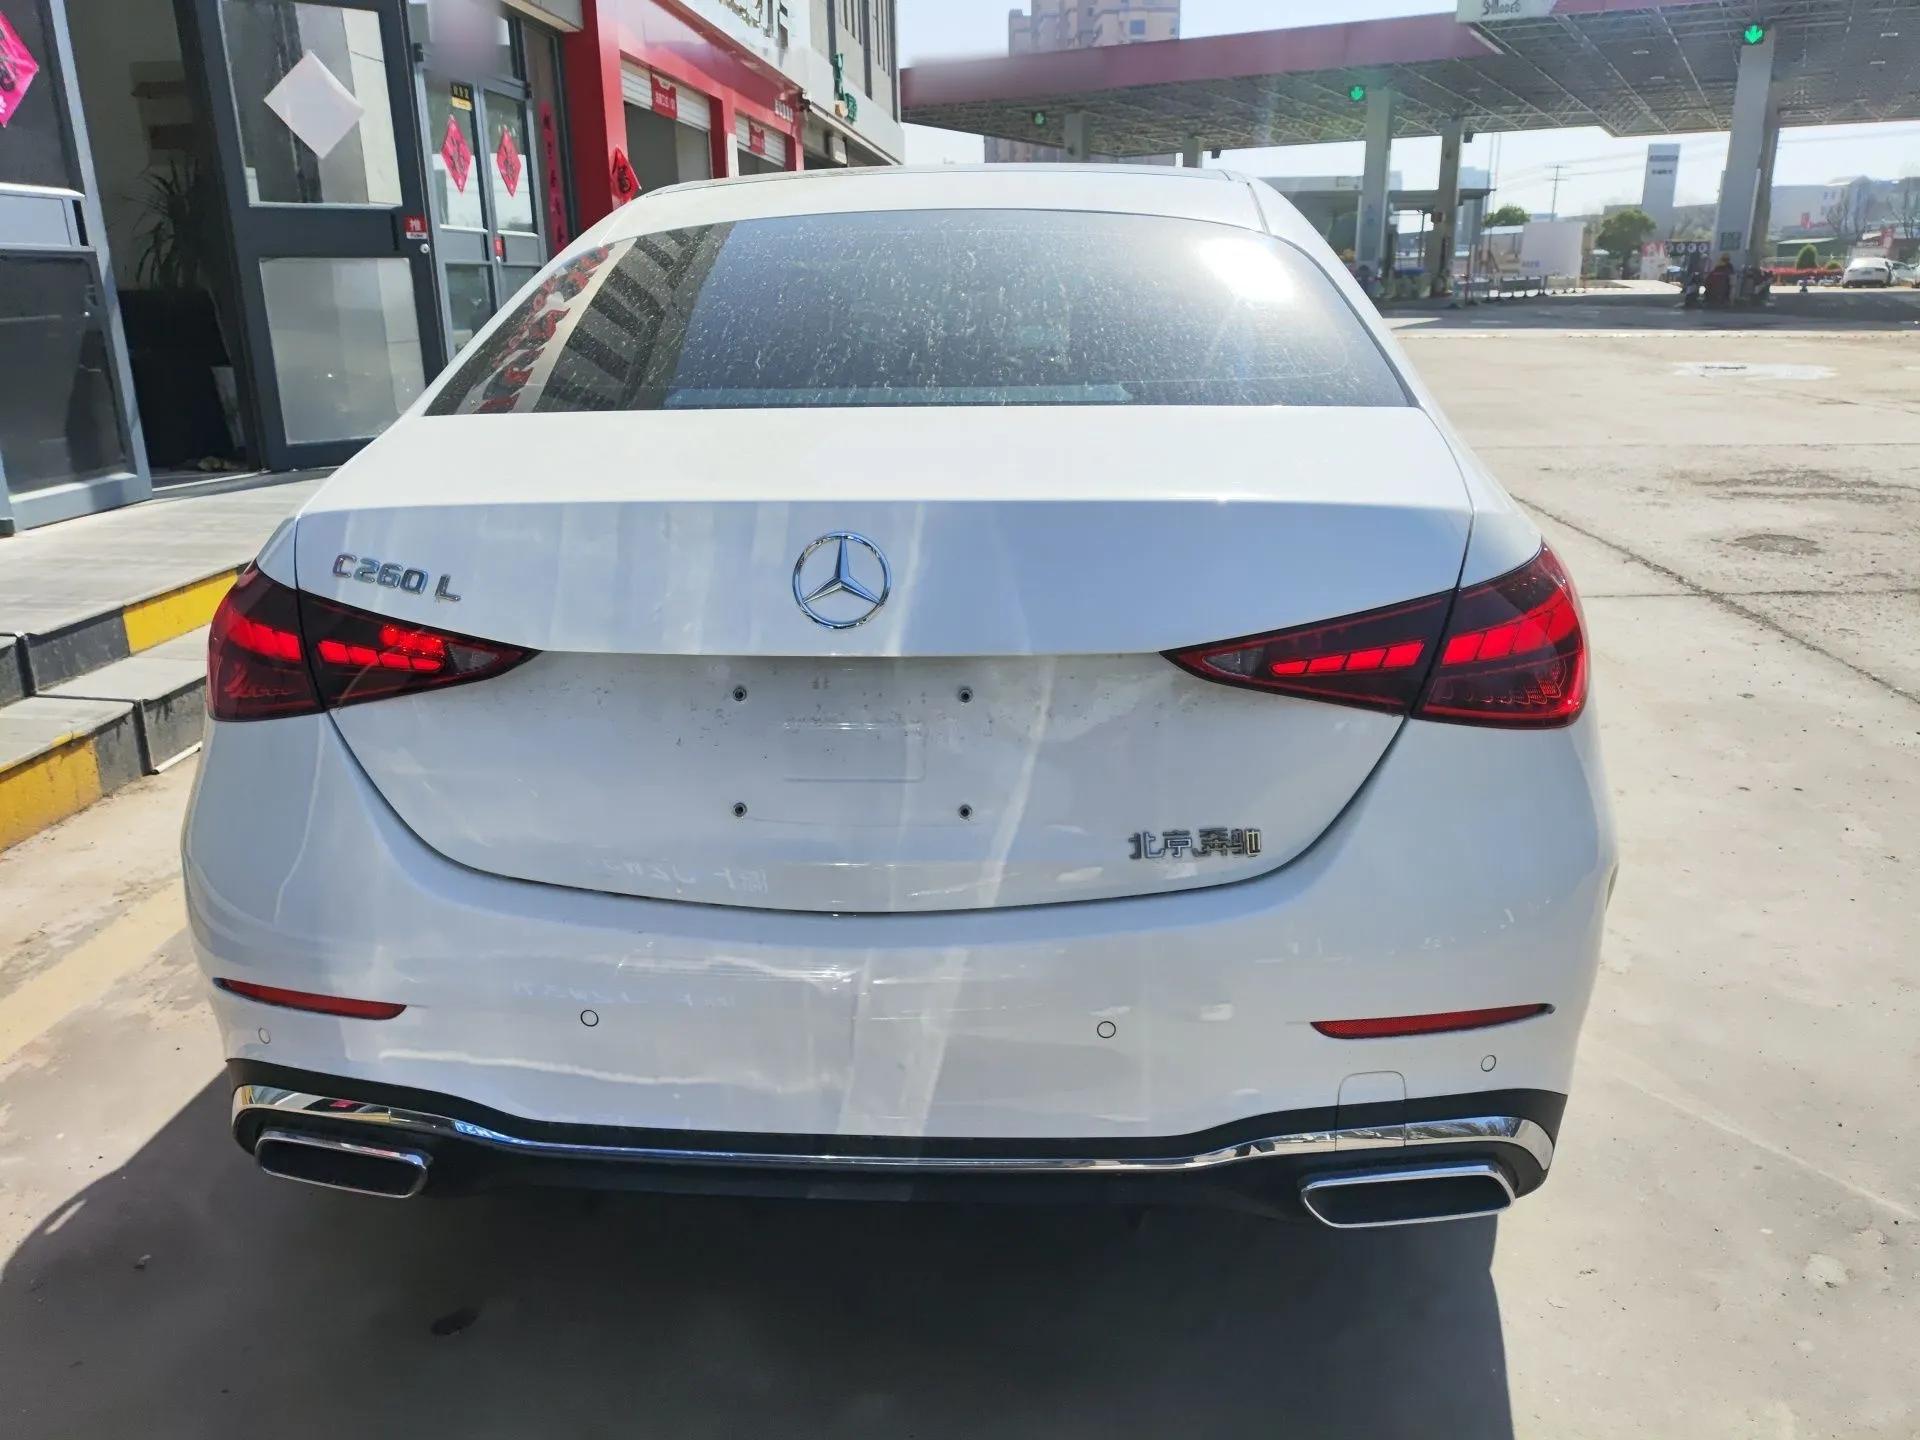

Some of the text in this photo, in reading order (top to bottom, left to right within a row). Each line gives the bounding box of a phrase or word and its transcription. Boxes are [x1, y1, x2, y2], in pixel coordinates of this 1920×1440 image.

[332, 553, 461, 601] C260 L
[1128, 827, 1261, 860] 北京奔驰
